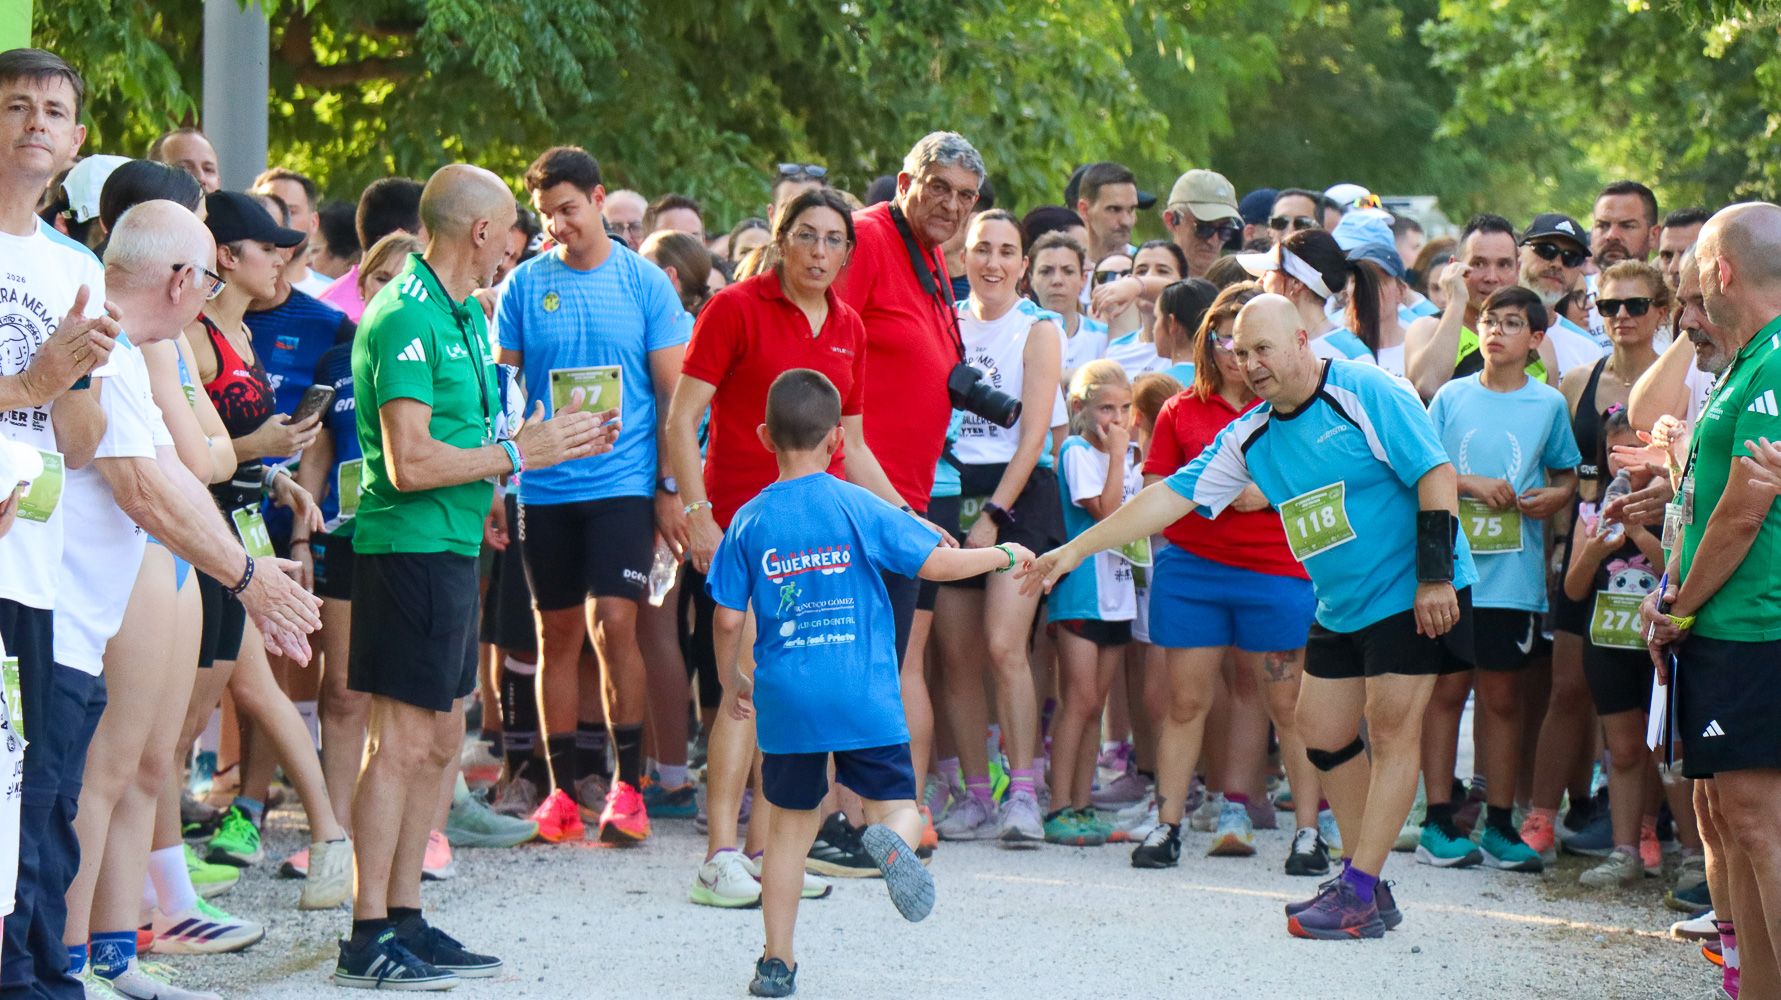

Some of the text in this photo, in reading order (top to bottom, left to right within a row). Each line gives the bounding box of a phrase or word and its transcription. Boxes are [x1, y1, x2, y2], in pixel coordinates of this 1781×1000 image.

[6, 272, 26, 284] 2026
[0, 287, 18, 303] RA
[1297, 505, 1336, 538] 118
[1472, 516, 1502, 537] 75
[762, 548, 851, 576] GUERRERO
